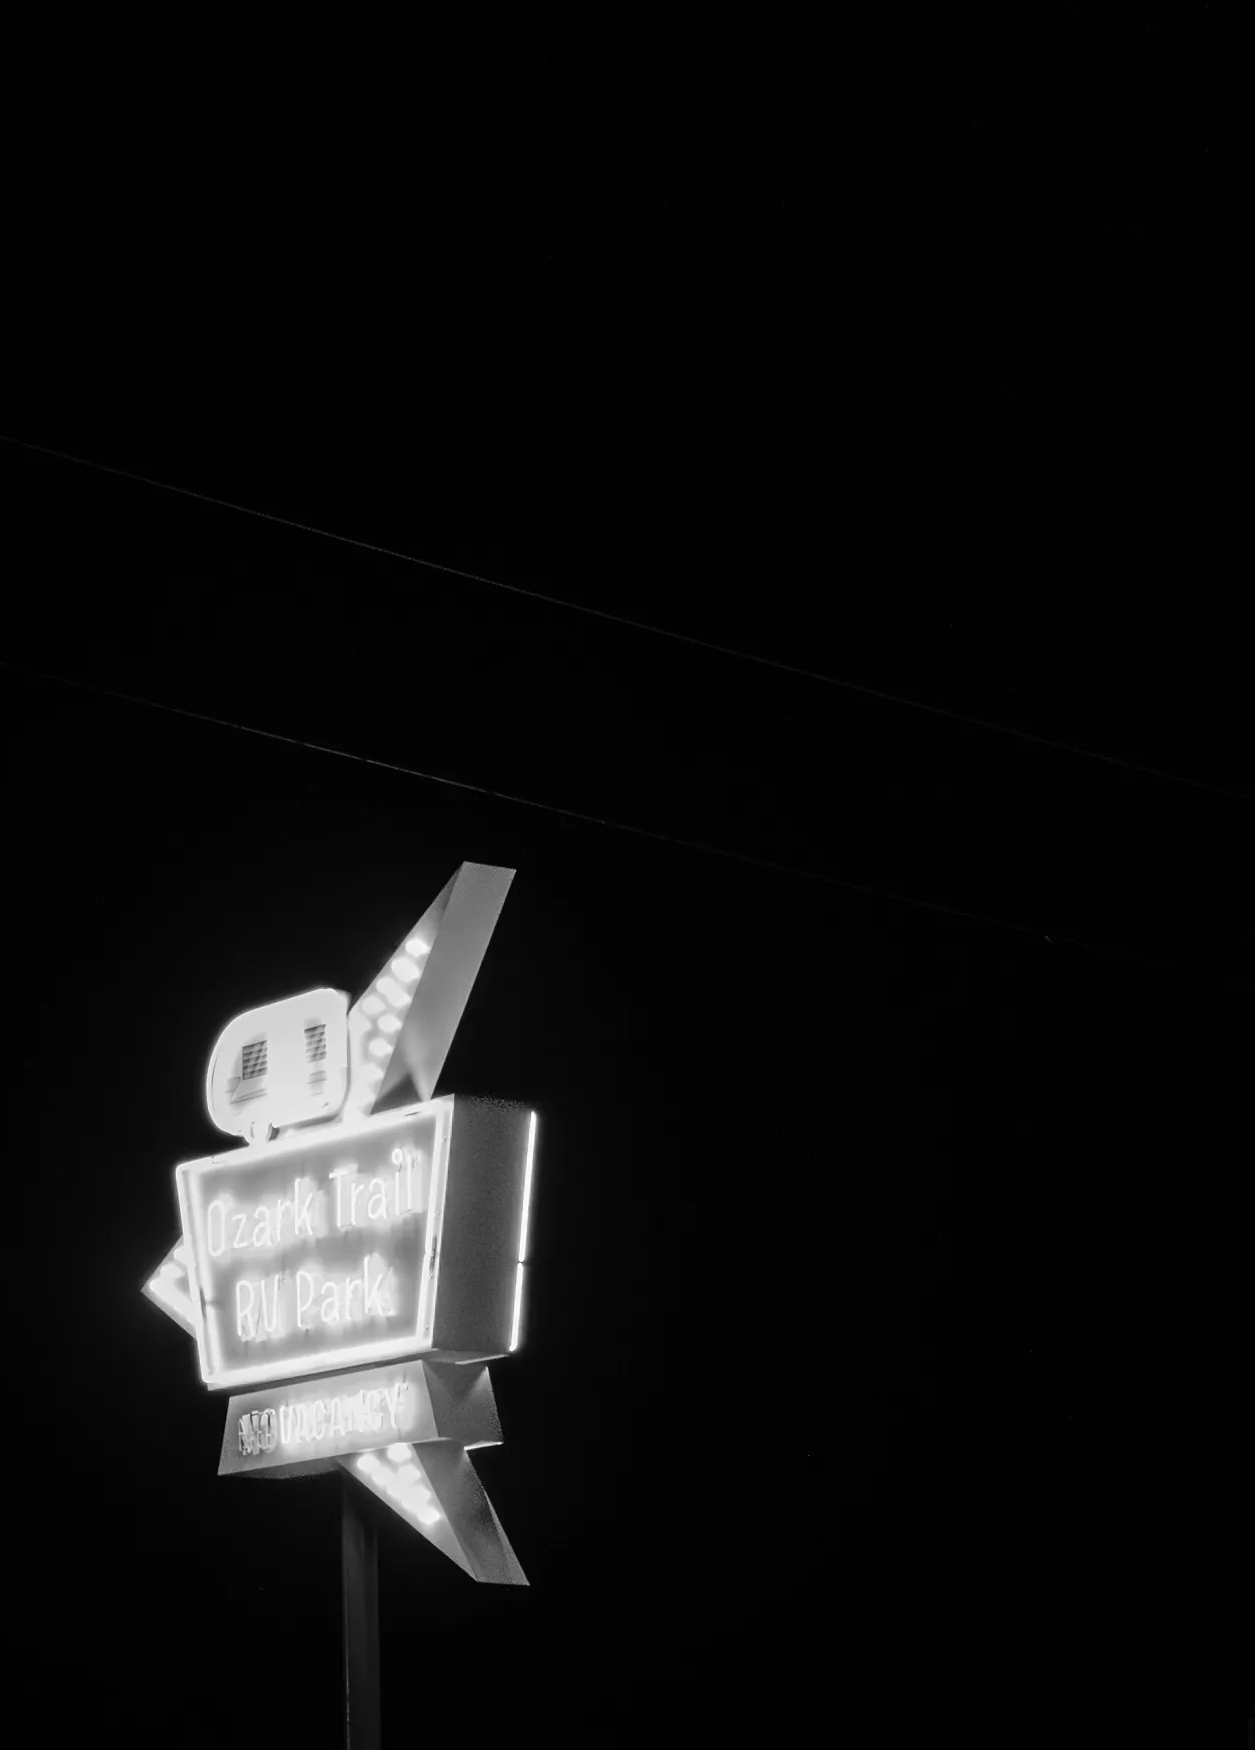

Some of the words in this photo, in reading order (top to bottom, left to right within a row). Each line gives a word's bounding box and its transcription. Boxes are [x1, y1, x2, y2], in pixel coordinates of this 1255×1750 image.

[207, 1176, 321, 1258] Ozark
[329, 1147, 422, 1230] Trail
[235, 1273, 286, 1342] RV
[295, 1253, 396, 1330] Park
[279, 1382, 411, 1443] VACANCY
